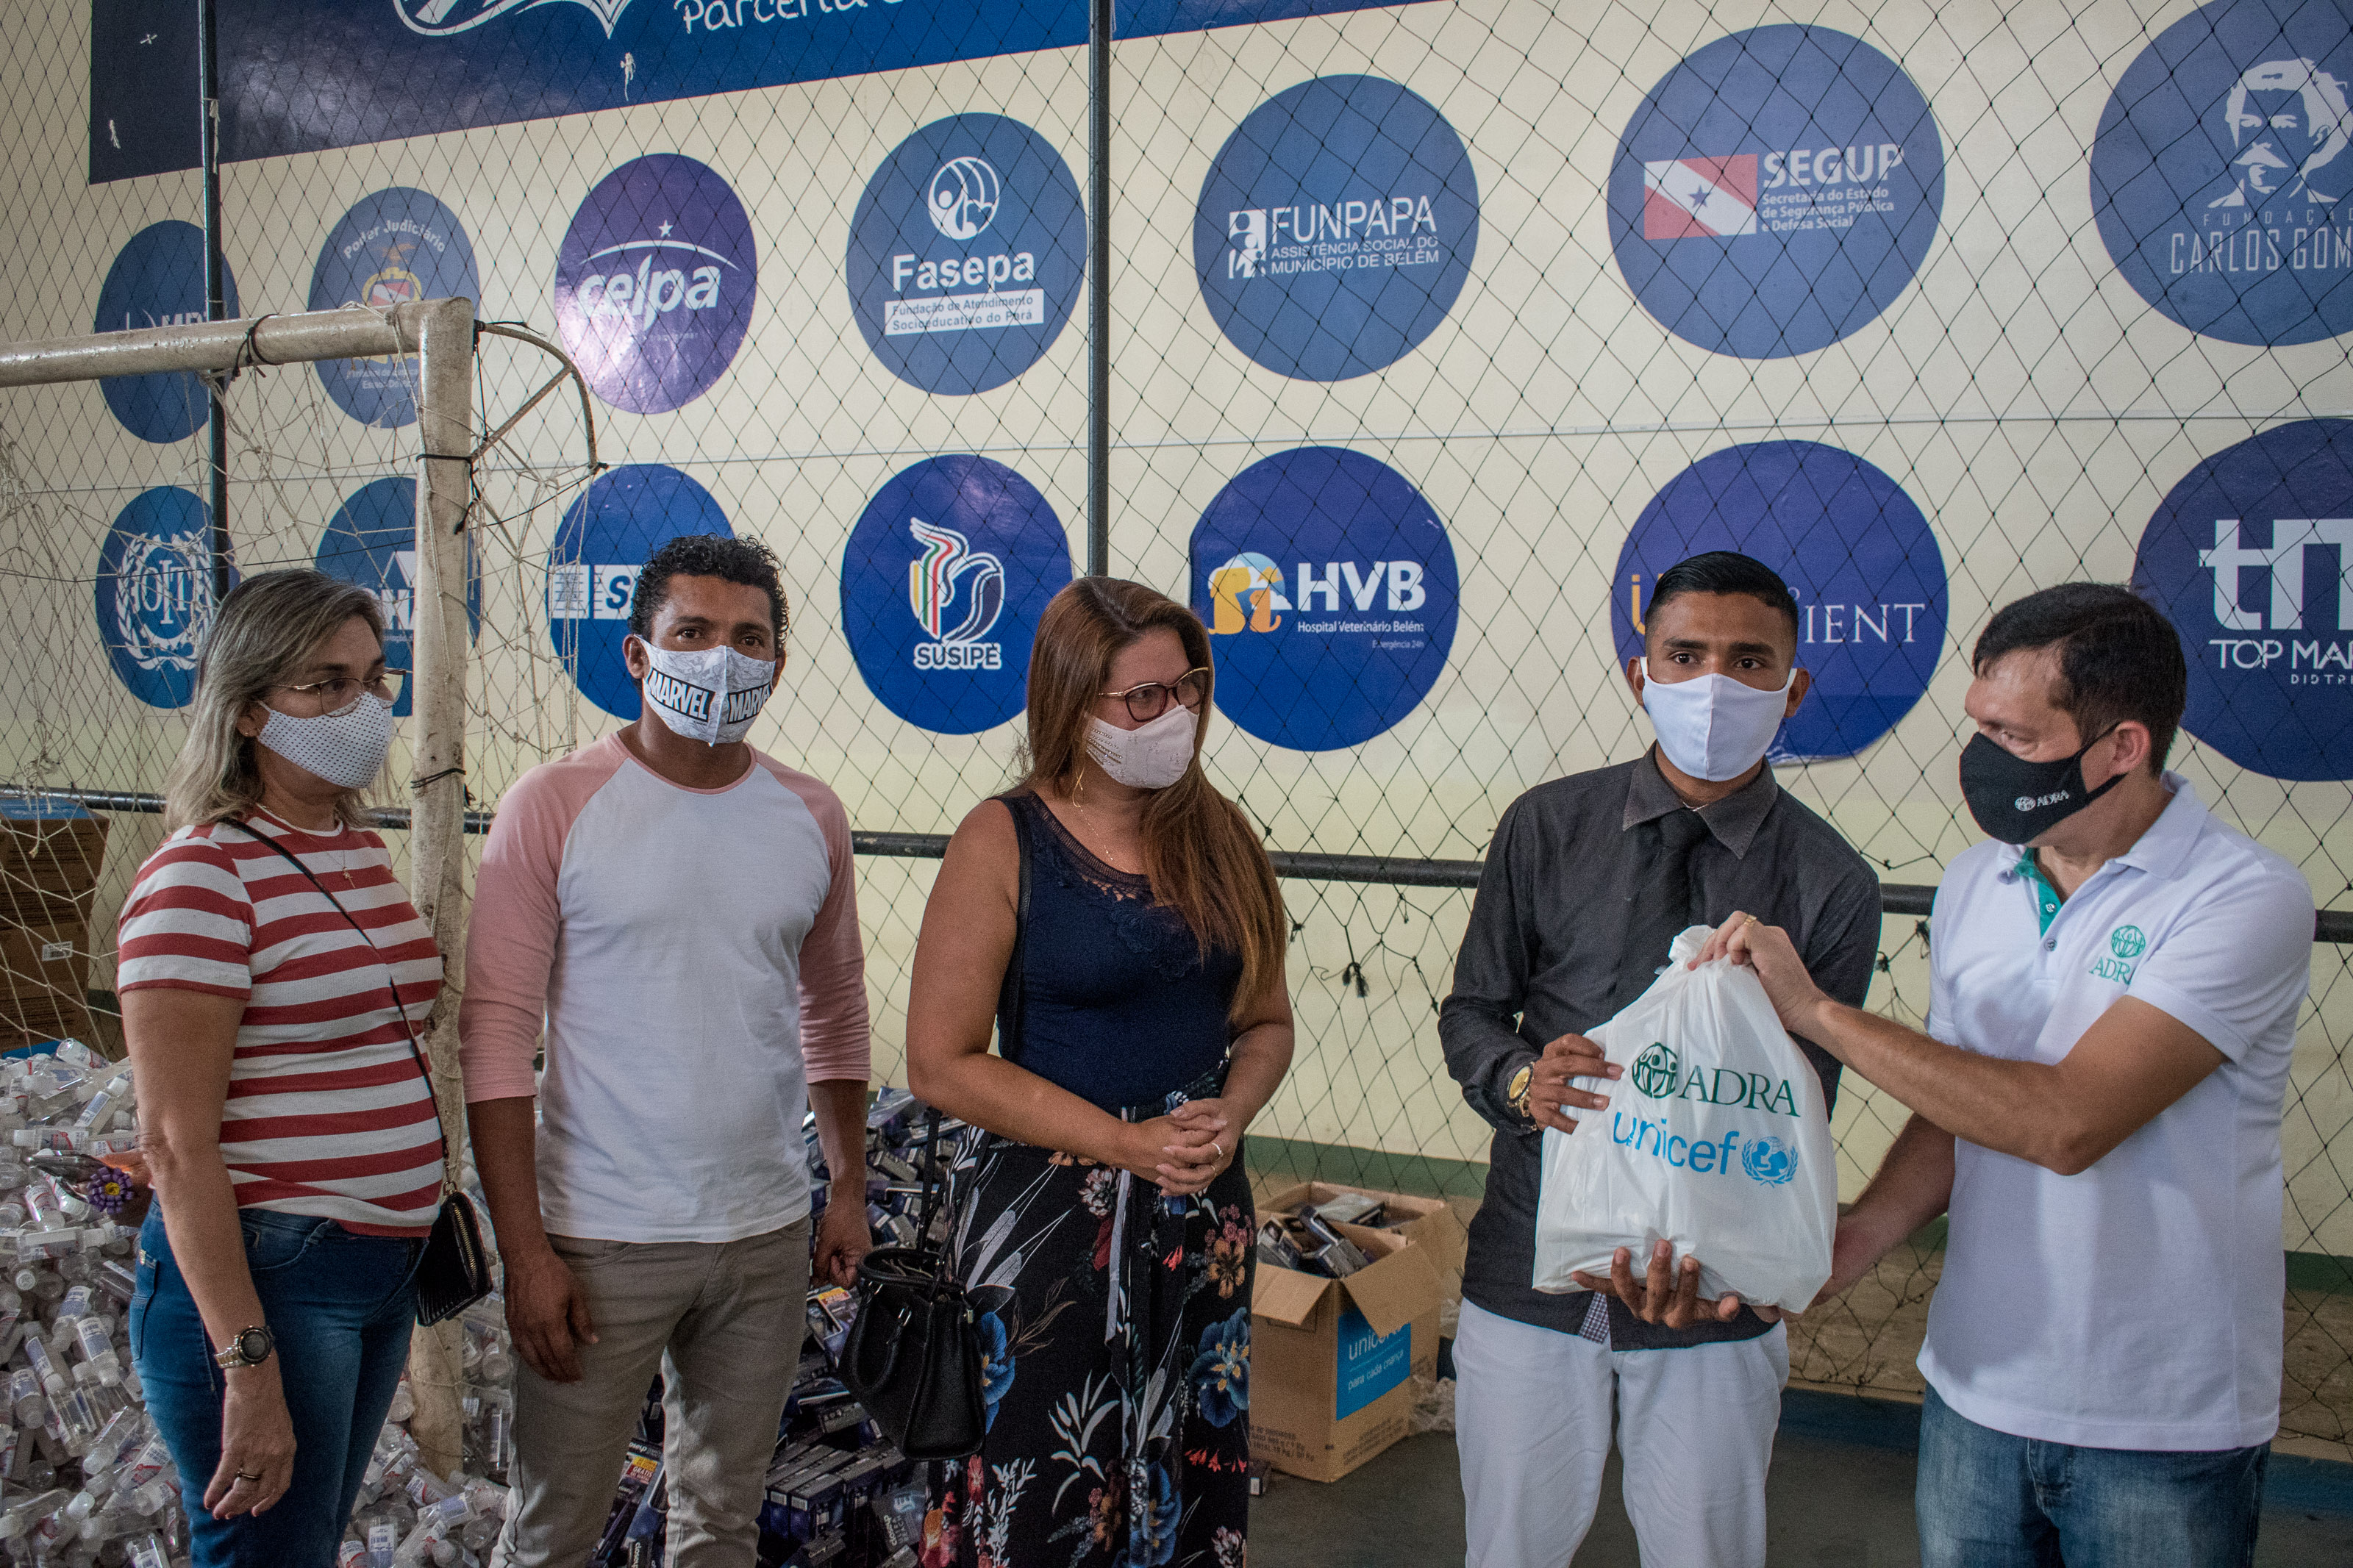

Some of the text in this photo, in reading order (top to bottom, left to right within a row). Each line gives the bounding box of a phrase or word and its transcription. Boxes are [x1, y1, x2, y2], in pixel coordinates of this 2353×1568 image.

[1763, 143, 1904, 188] SEGUP
[1763, 187, 1888, 204] Secretaria do Estado
[1271, 196, 1437, 244] FUNPAPA
[1762, 201, 1894, 220] de Segurança Pública
[1762, 215, 1854, 232] e Defesa Social
[344, 219, 445, 259] Poder Judiciário
[1271, 235, 1438, 259] ASSISTÊNCIA SOCIAL DO
[2171, 226, 2353, 273] CARLOS GOM
[893, 252, 1035, 293] Fasepa
[1271, 248, 1439, 274] MUNICÍPIO DE BELÉM
[577, 254, 721, 332] celpa
[893, 296, 1033, 315] Fundação de Atendimento
[893, 310, 1032, 331] Socioeducativo do Pará
[1298, 561, 1426, 611] HVB
[1298, 620, 1424, 634] Hospital Veterinário Belém
[1804, 604, 1925, 643] IENT
[917, 646, 999, 666] SUSIPE
[2208, 640, 2353, 669] TOP MA
[2291, 674, 2353, 684] DISTR
[647, 670, 710, 720] MARVEL
[2037, 790, 2070, 806] ADRA
[2088, 956, 2131, 985] ADR
[1677, 1065, 1801, 1117] ADRA
[1613, 1111, 1740, 1175] unicef
[1349, 1328, 1389, 1361] unic
